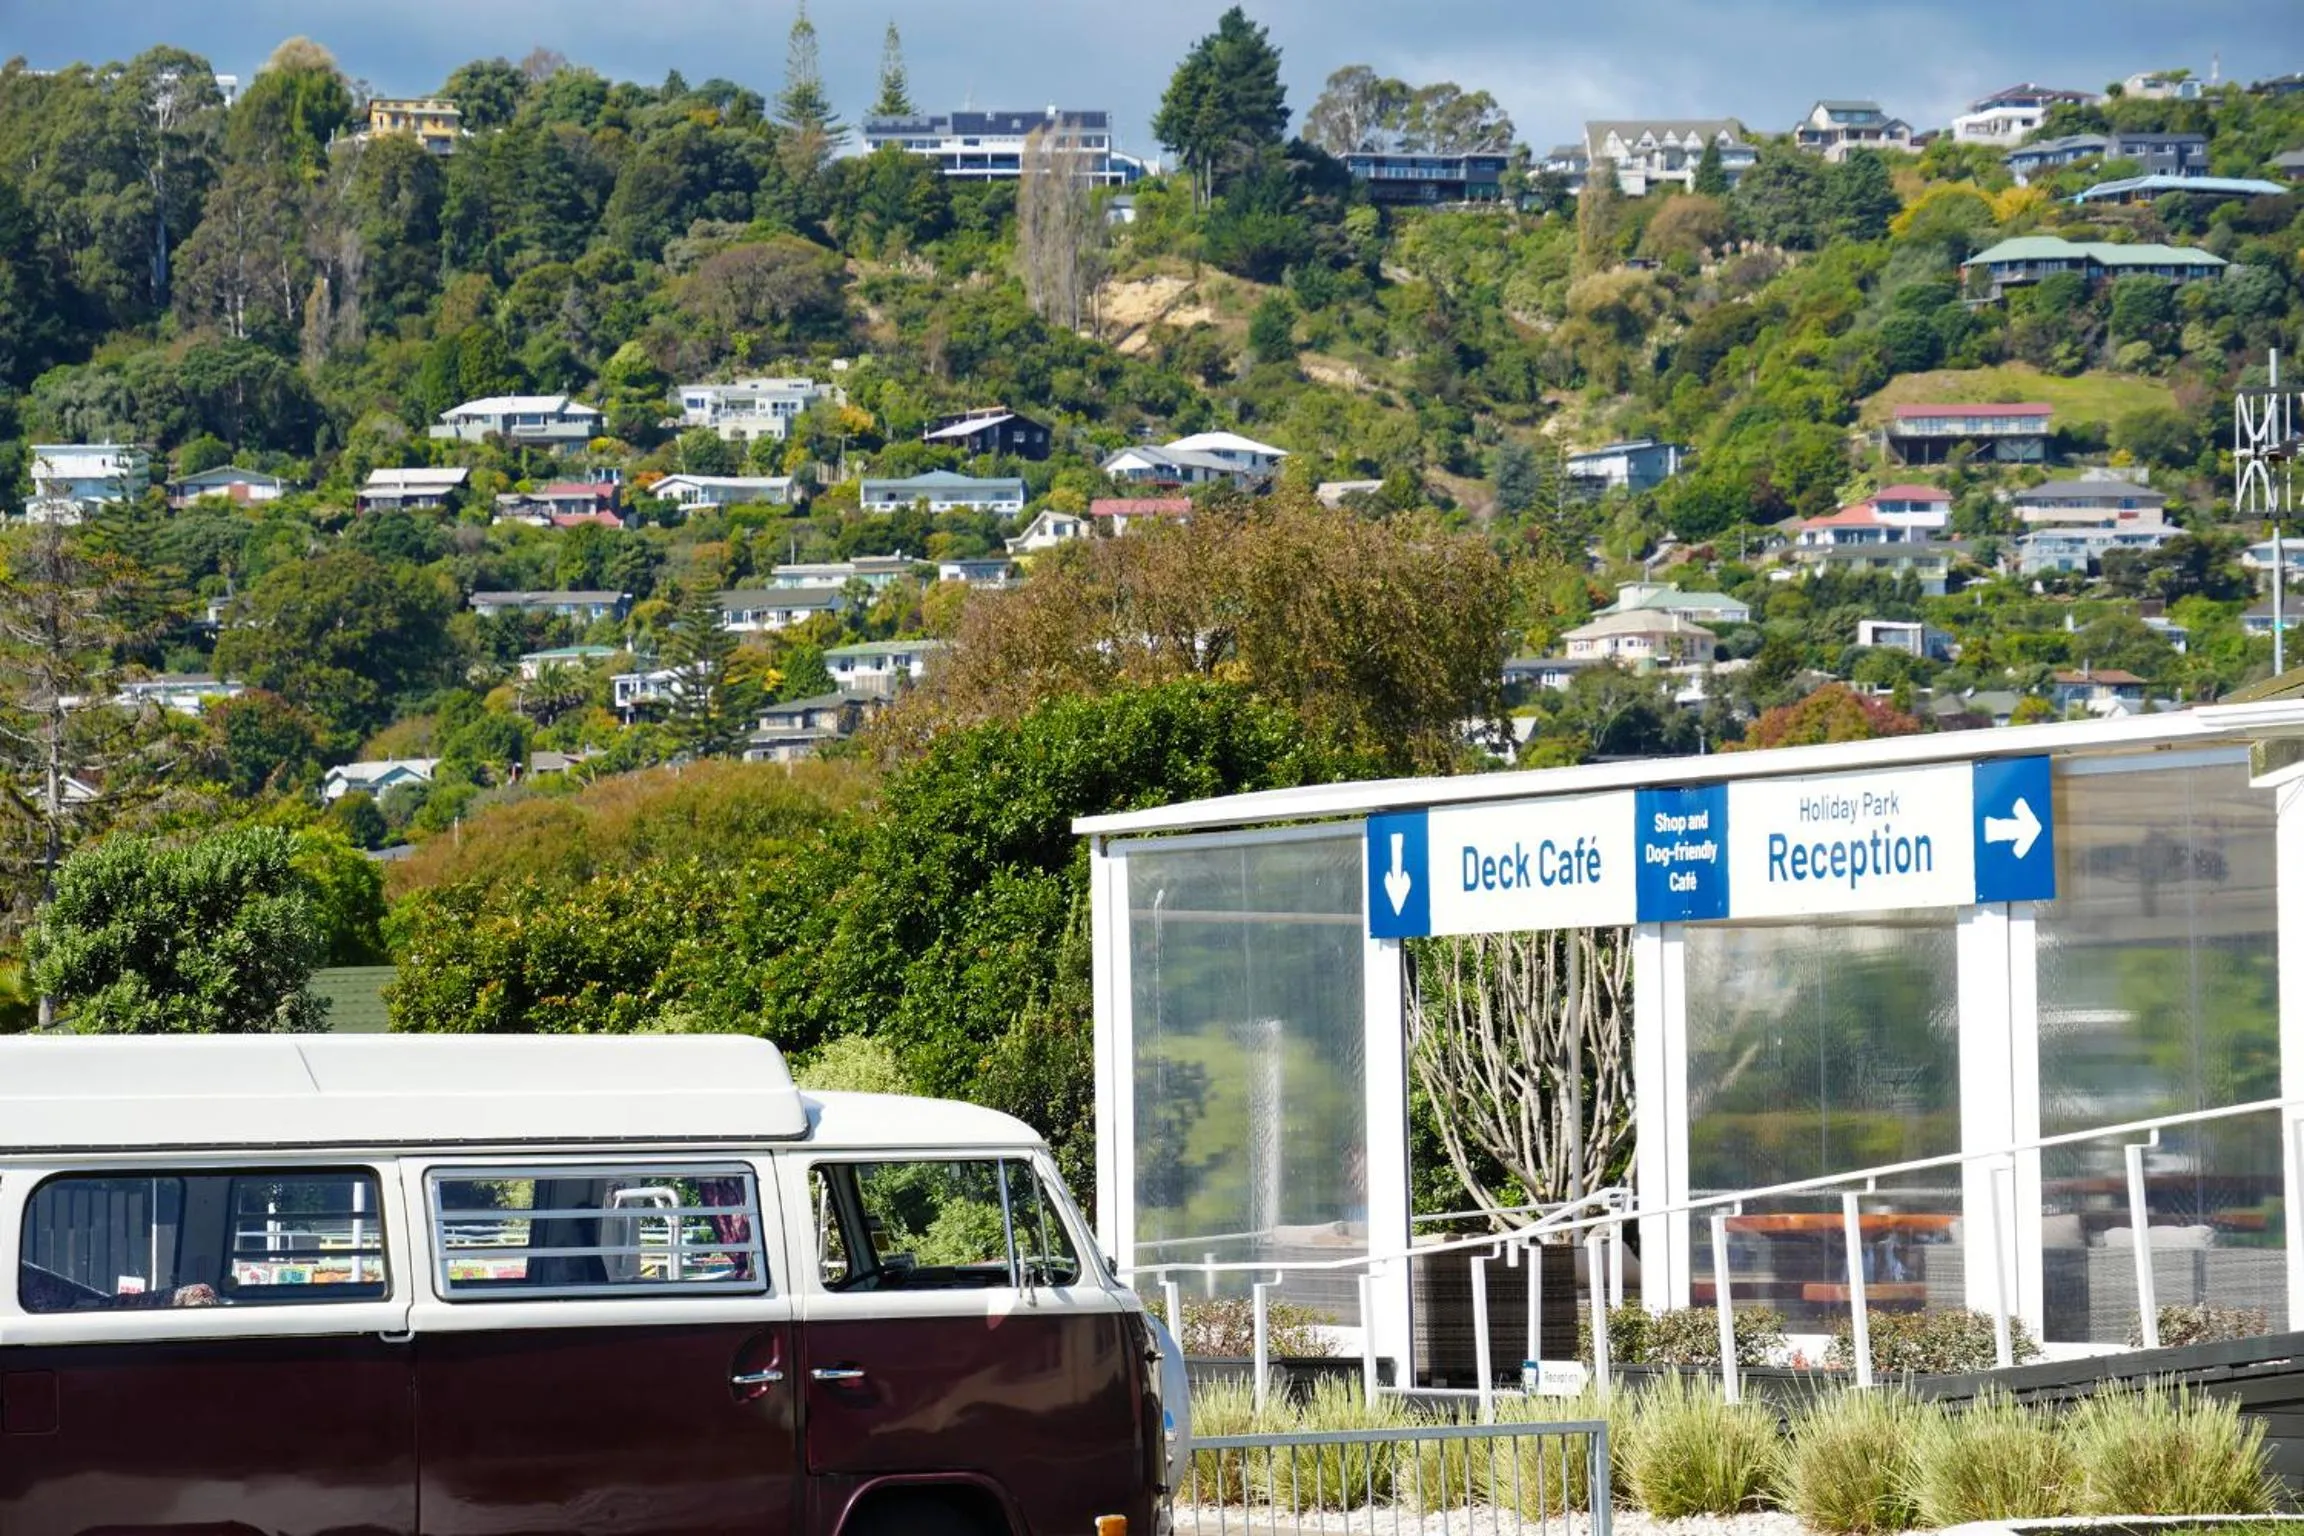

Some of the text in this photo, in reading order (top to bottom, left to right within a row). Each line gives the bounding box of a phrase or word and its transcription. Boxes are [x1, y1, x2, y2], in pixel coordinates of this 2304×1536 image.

[1800, 790, 1900, 824] Holiday Park
[1654, 809, 1709, 836] Shop and
[1462, 836, 1601, 892] Deck Café
[1646, 840, 1718, 867] Dog-friendly
[1768, 823, 1932, 890] Reception
[1669, 870, 1698, 892] Café
